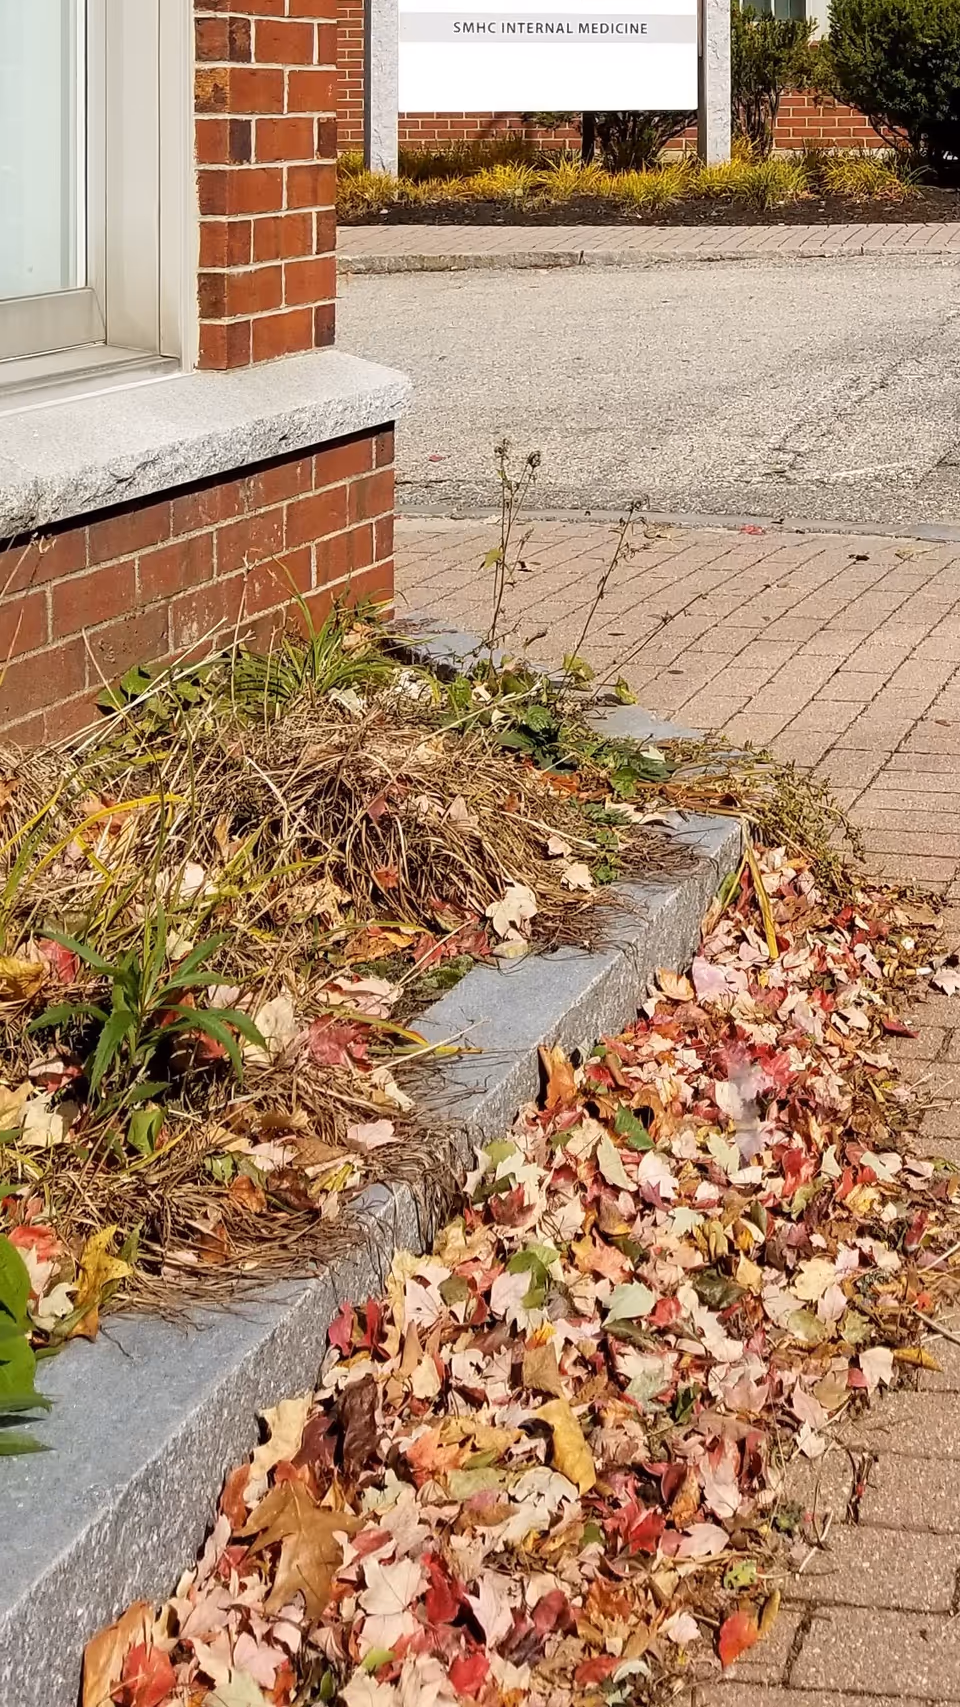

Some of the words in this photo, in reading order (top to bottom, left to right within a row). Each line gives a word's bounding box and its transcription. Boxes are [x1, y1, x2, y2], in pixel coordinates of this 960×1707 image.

[453, 22, 496, 34] SMHC
[501, 22, 574, 34] INTERNAL
[578, 23, 648, 35] MEDICINE
